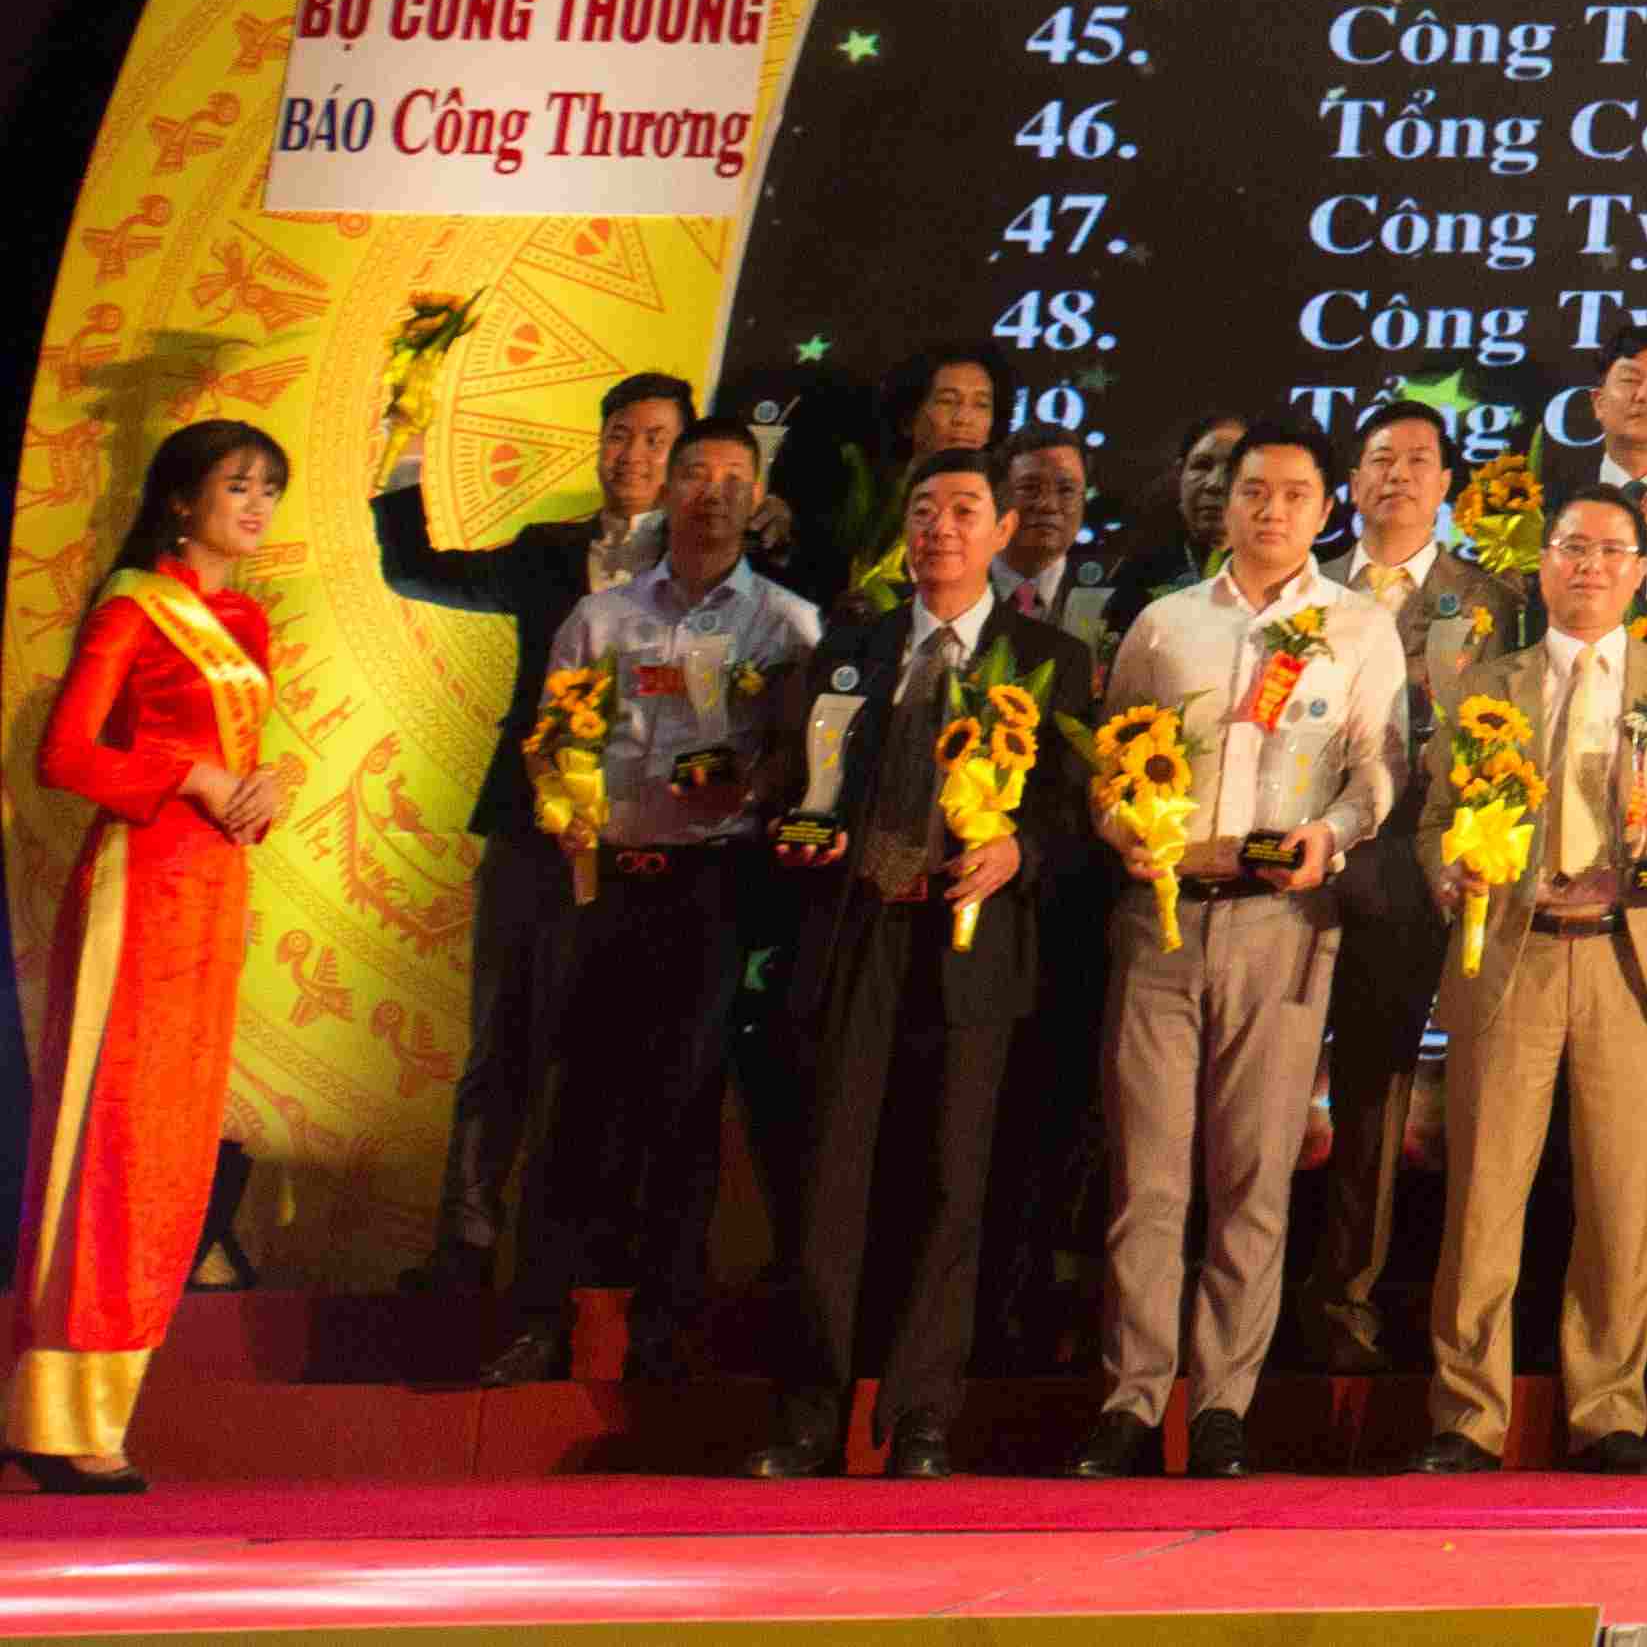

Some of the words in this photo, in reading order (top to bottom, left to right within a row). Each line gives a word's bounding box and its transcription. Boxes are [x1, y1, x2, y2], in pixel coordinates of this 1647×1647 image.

[1026, 5, 1149, 65] 45.
[1329, 6, 1556, 80] Công
[280, 83, 374, 154] BÁO
[392, 87, 531, 175] Công
[547, 92, 752, 179] Thương
[1015, 99, 1138, 160] 46.
[1320, 89, 1541, 174] Tổng
[1003, 194, 1128, 256] 47.
[1309, 195, 1537, 270] Công
[992, 290, 1117, 352] 48.
[1299, 290, 1529, 366] Công
